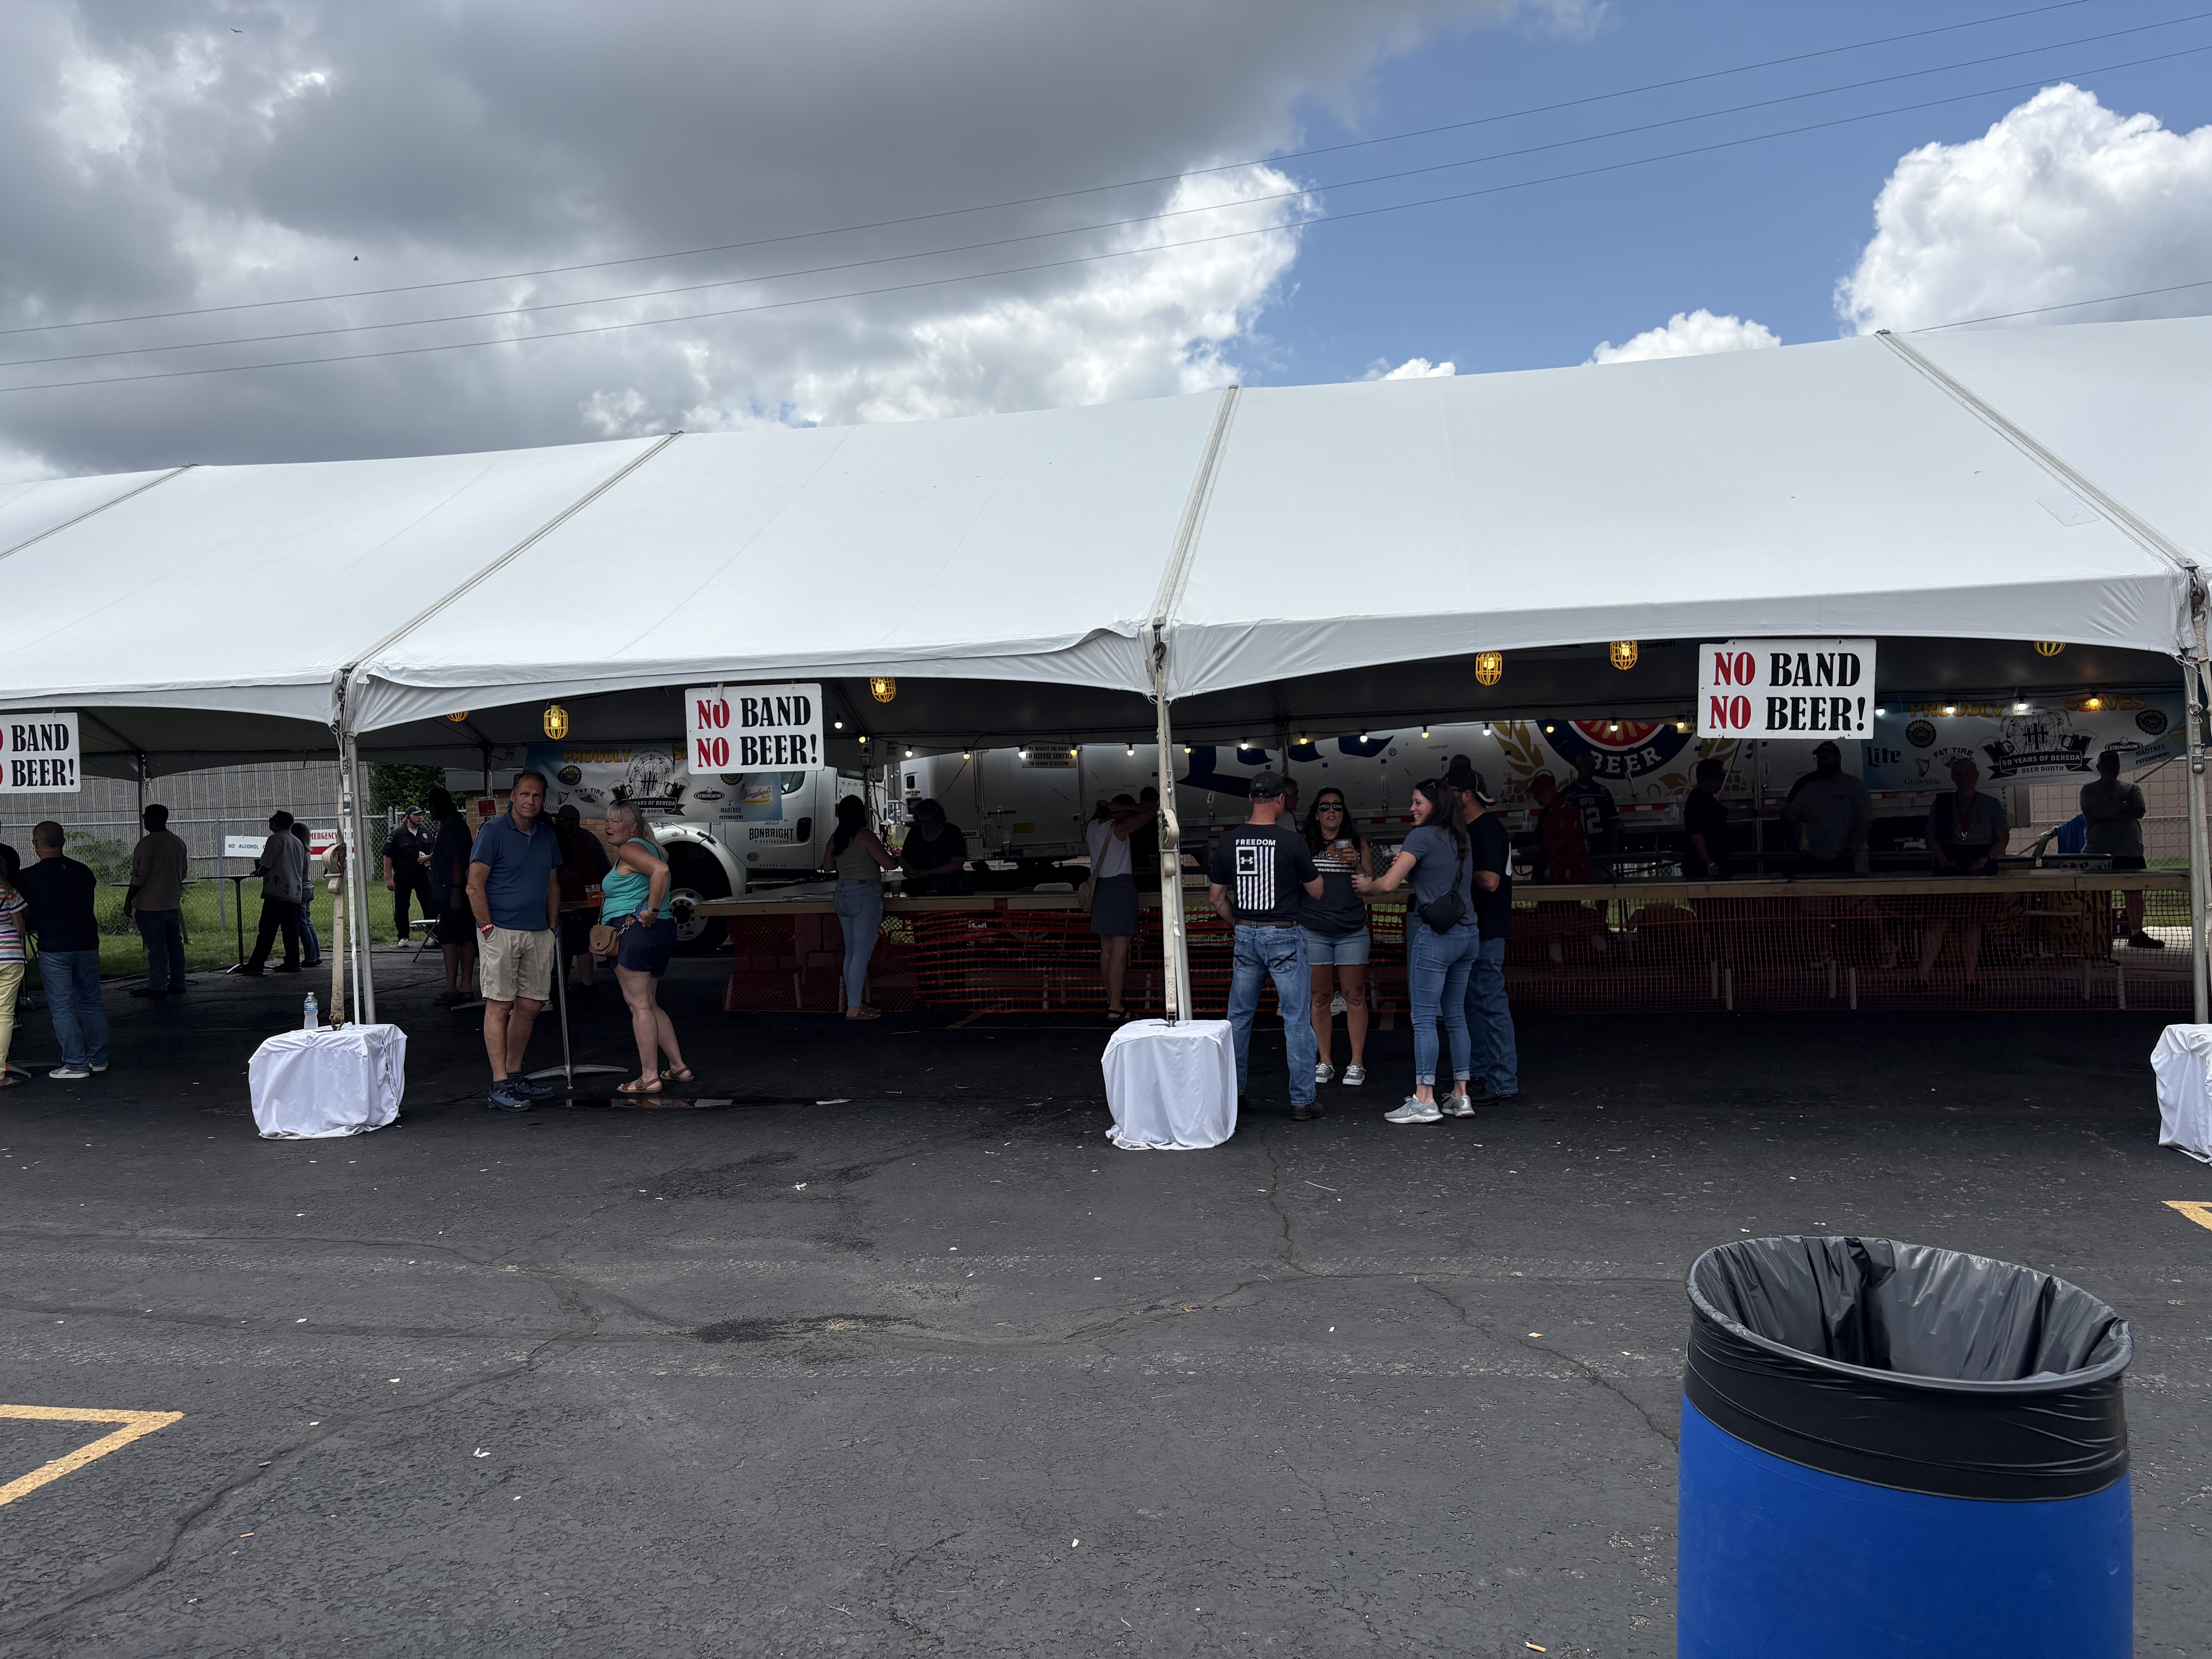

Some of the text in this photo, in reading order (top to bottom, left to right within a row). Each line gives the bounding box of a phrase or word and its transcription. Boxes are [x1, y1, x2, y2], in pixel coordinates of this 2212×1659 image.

[1714, 652, 1860, 686] NO BAND
[697, 696, 811, 729] NO BAND
[1709, 696, 1865, 731] NO BEER!
[1910, 701, 2006, 718] PROUDLY
[11, 724, 69, 752] BAND
[564, 748, 632, 763] PROUDLY
[697, 737, 729, 767] NO
[740, 734, 817, 766] BEER!
[1590, 747, 1662, 773] BEER
[1867, 747, 1901, 768] Lite
[1933, 747, 1974, 758] FAT TIRE
[2014, 756, 2037, 764] YEARS
[11, 759, 74, 786] BEER!
[590, 788, 605, 797] TIRE
[749, 828, 793, 840] BONBRIGHT
